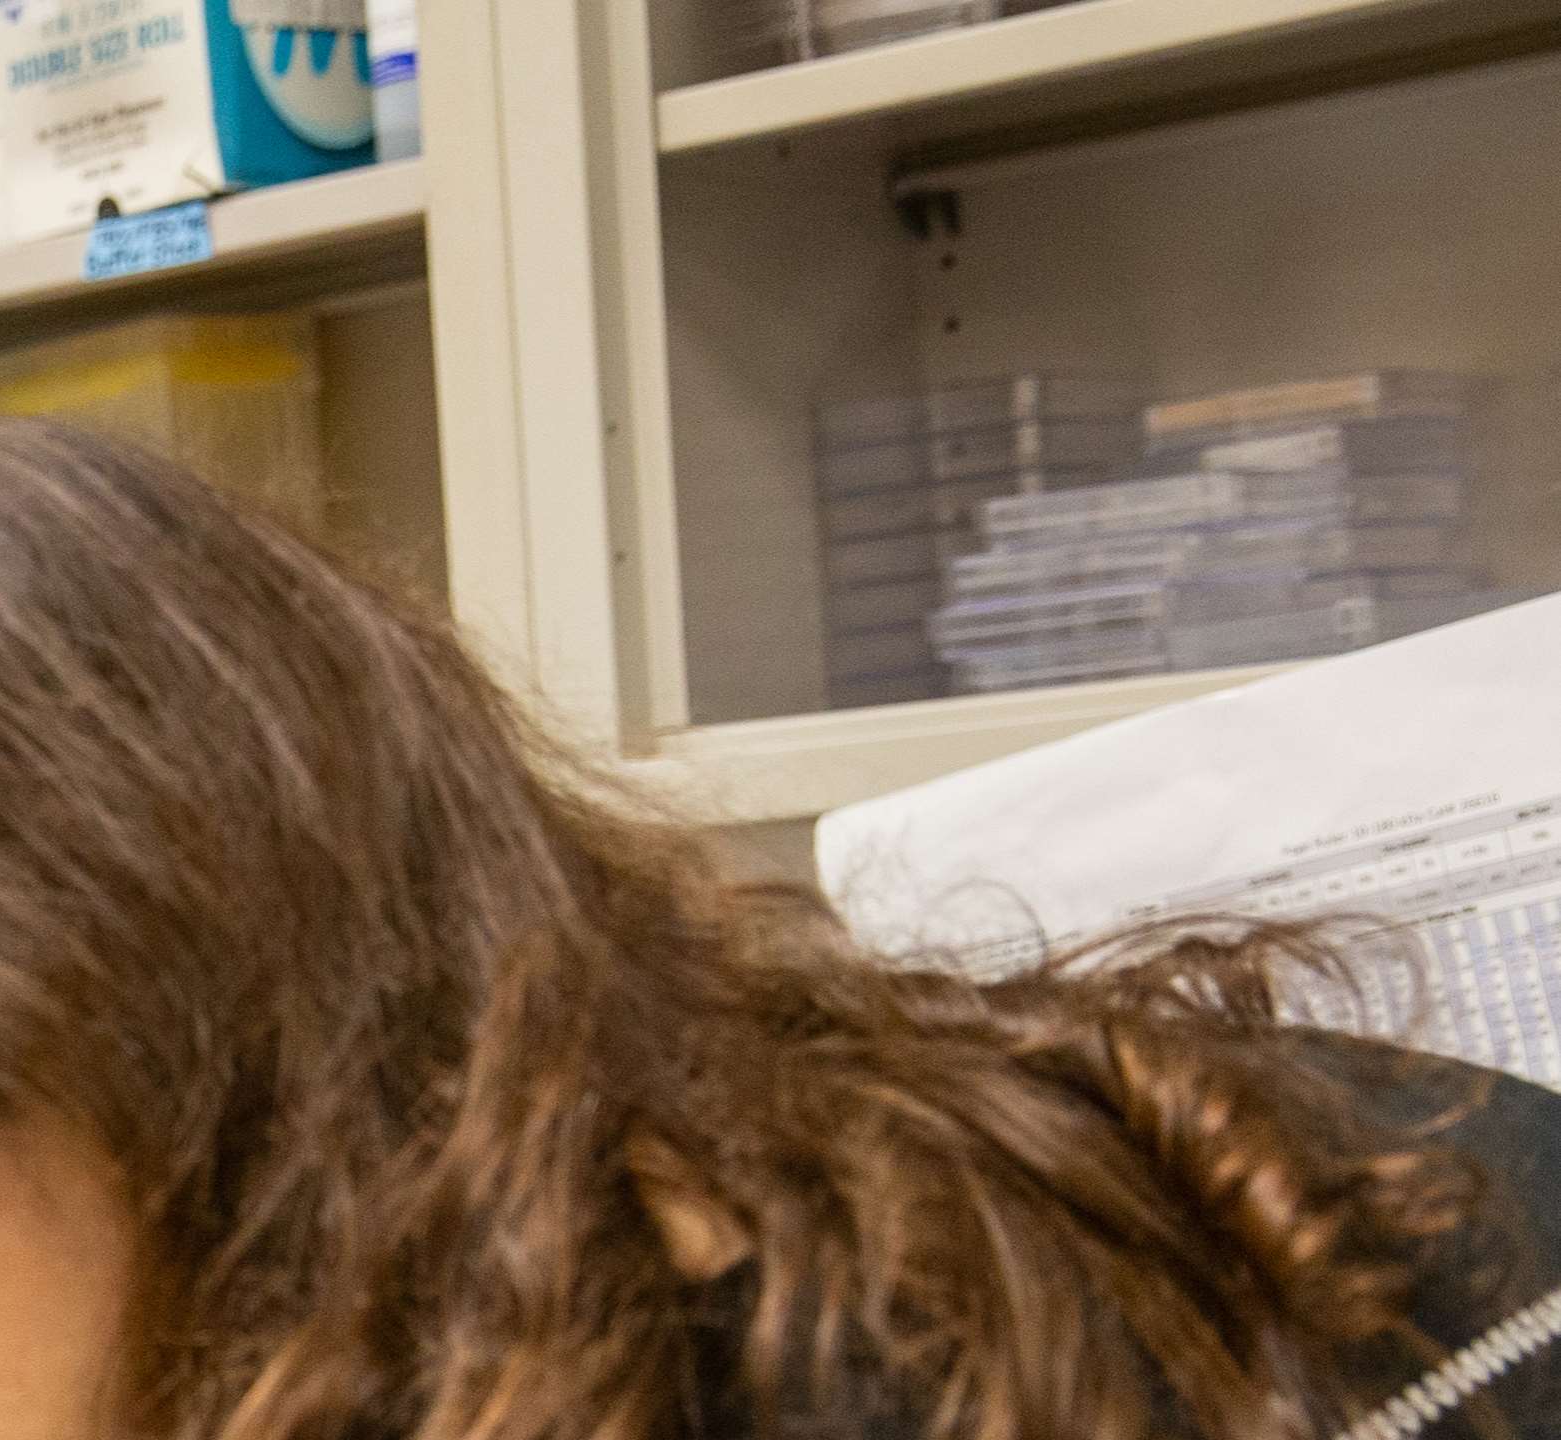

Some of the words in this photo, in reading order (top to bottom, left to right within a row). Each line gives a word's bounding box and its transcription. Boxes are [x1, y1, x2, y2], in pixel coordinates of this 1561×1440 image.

[7, 46, 81, 90] DOUBLE
[89, 29, 128, 64] SIZE
[138, 15, 184, 48] ROLL
